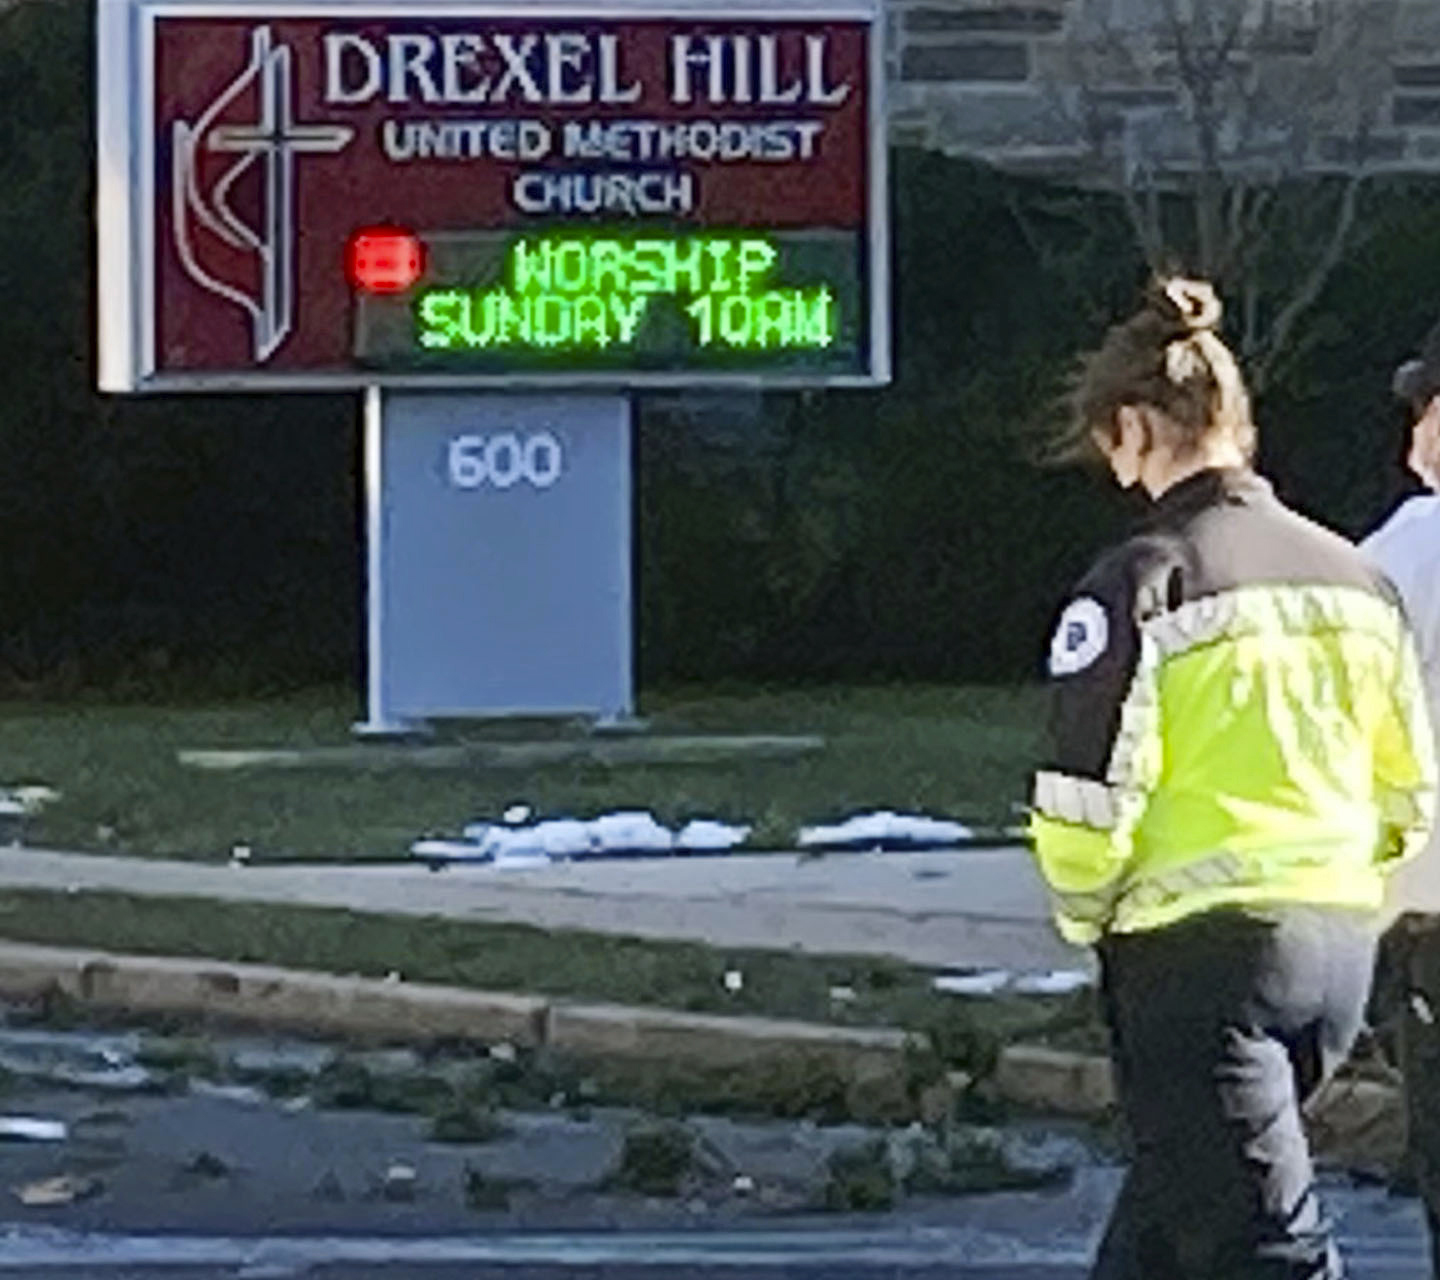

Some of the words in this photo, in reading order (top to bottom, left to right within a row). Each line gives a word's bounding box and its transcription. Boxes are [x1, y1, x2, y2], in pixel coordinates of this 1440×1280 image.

[323, 33, 642, 105] DREXEL
[669, 33, 852, 105] HILL
[382, 121, 552, 159] UNITED
[563, 121, 825, 159] METHODIST
[513, 173, 693, 212] CHURCH
[512, 239, 777, 294] WORSHIP
[418, 289, 648, 349] SUNDAY
[686, 289, 834, 348] 10AM
[448, 434, 563, 488] 600
